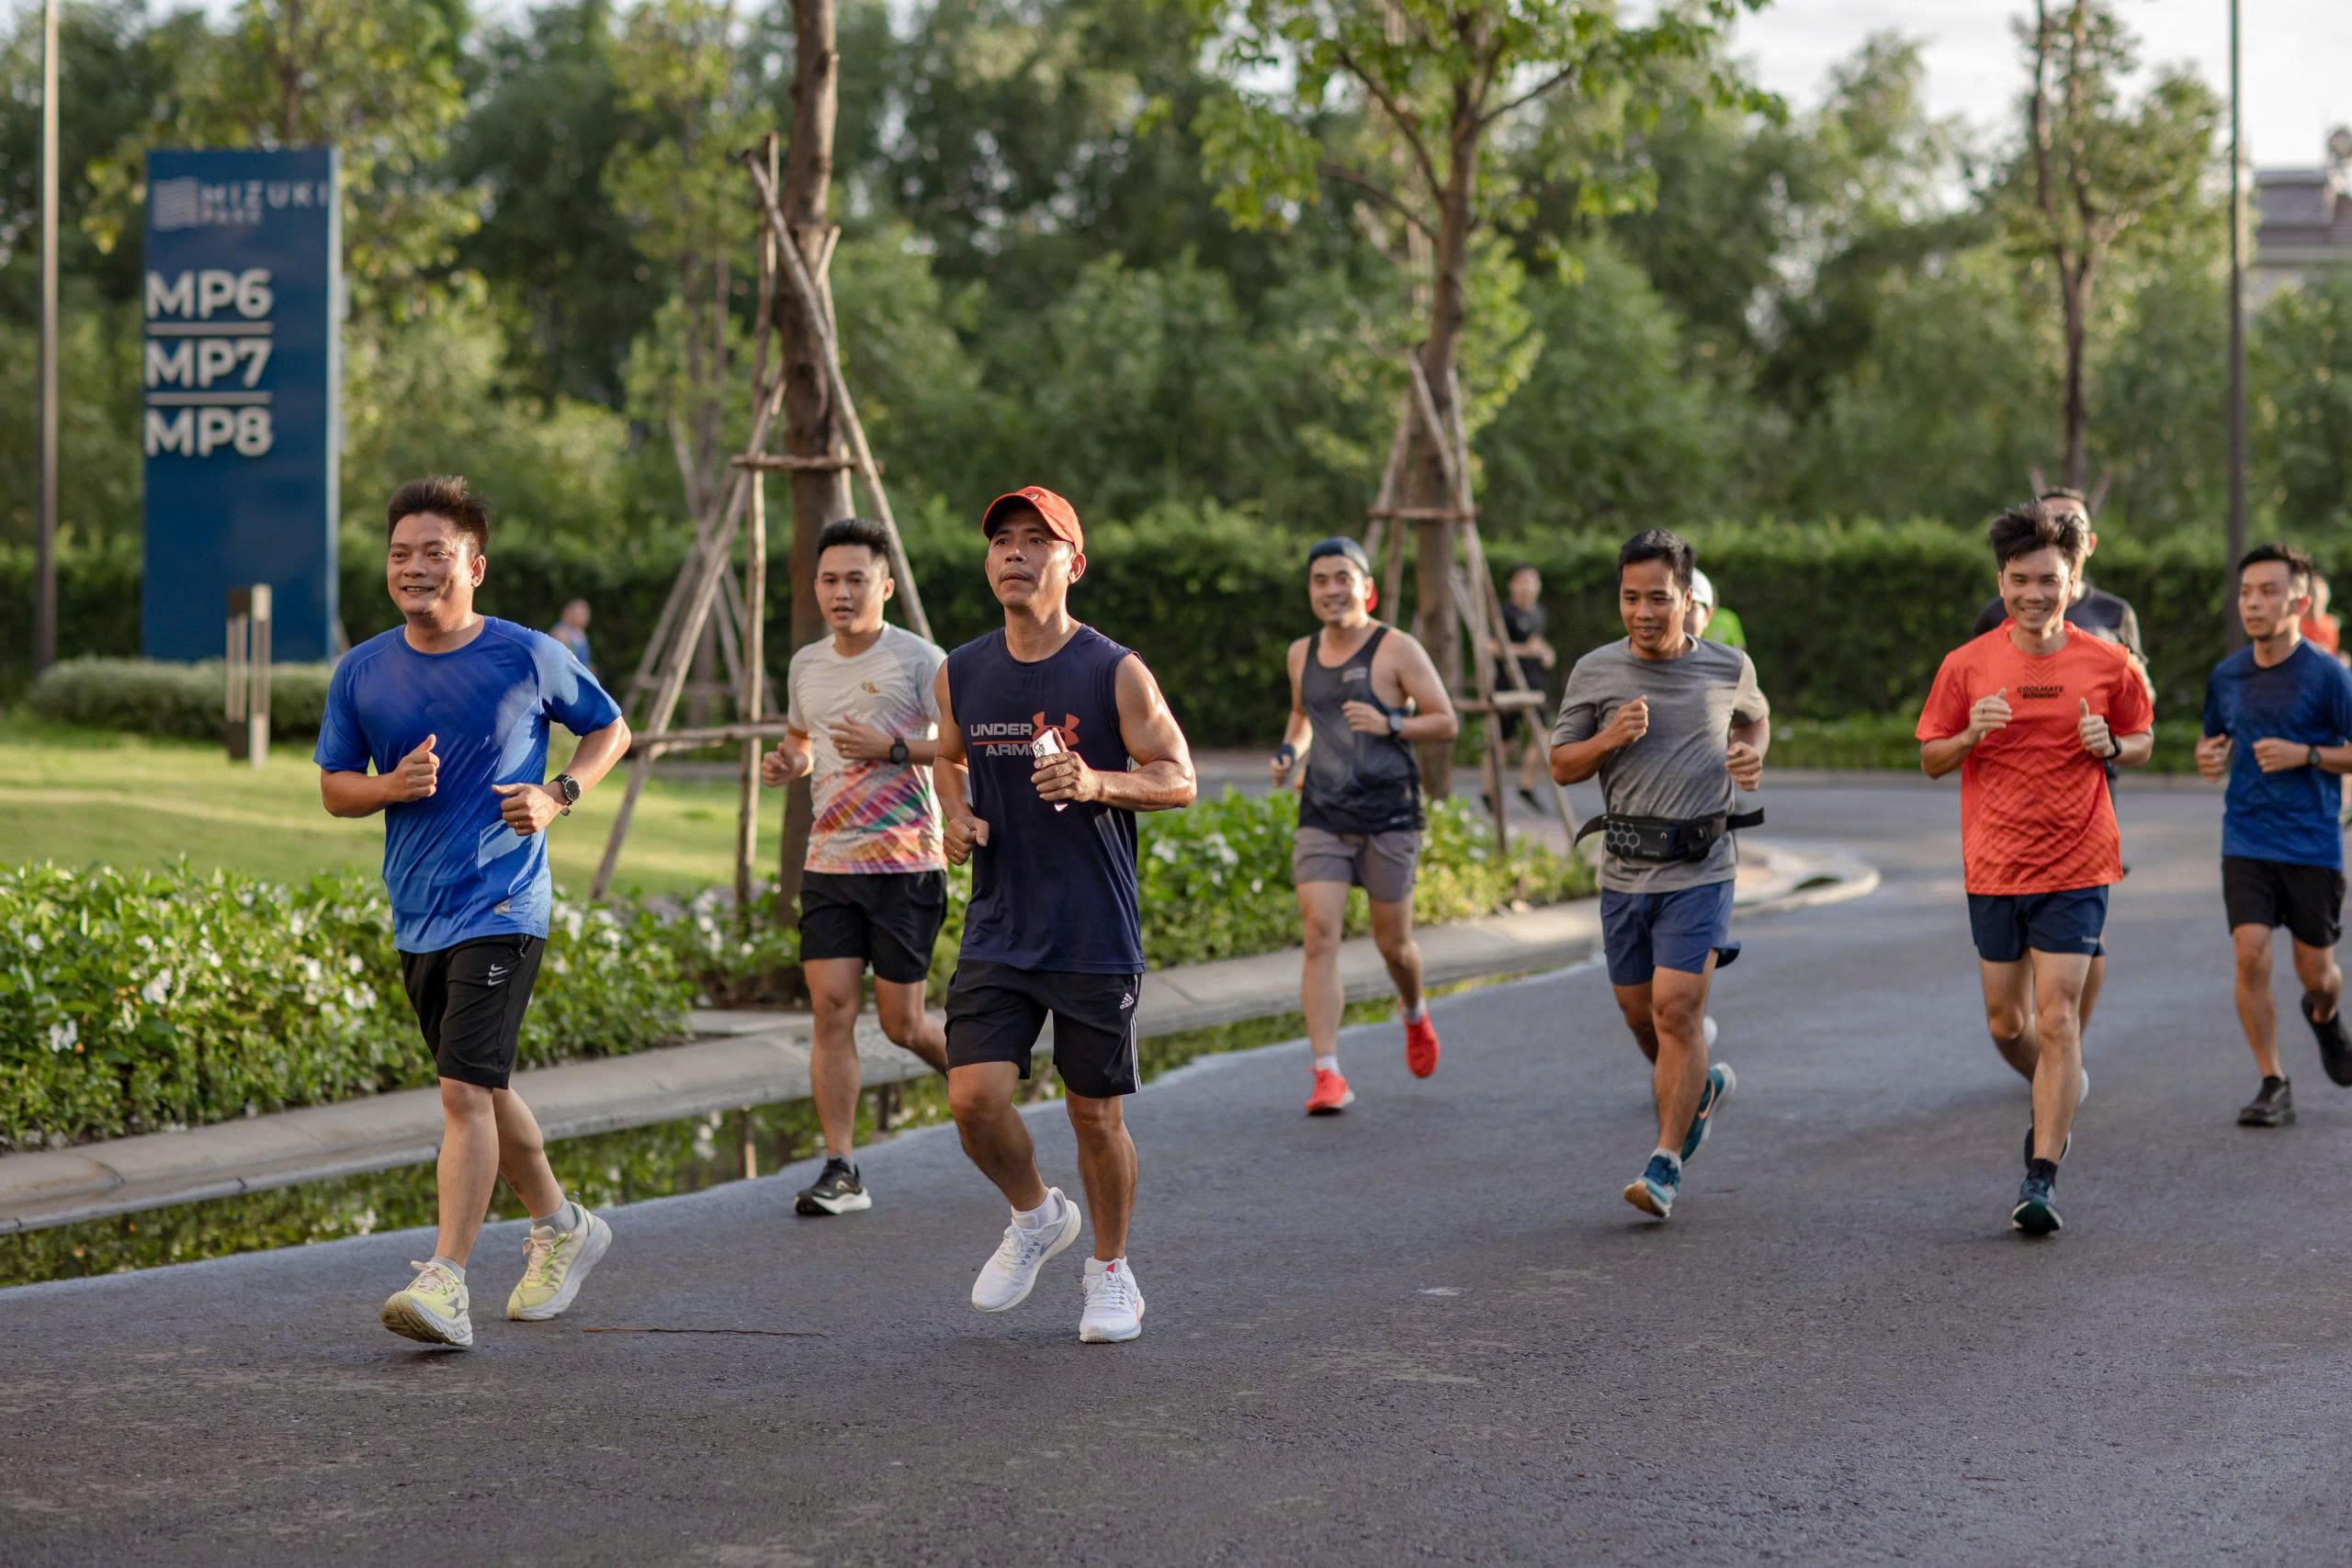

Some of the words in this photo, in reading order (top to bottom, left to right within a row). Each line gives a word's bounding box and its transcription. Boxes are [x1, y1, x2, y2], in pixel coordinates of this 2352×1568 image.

[146, 268, 273, 319] MP6
[146, 337, 273, 388] MP7
[146, 405, 273, 457] MP8
[970, 723, 1033, 736] UNDER
[986, 743, 1032, 756] ARM
